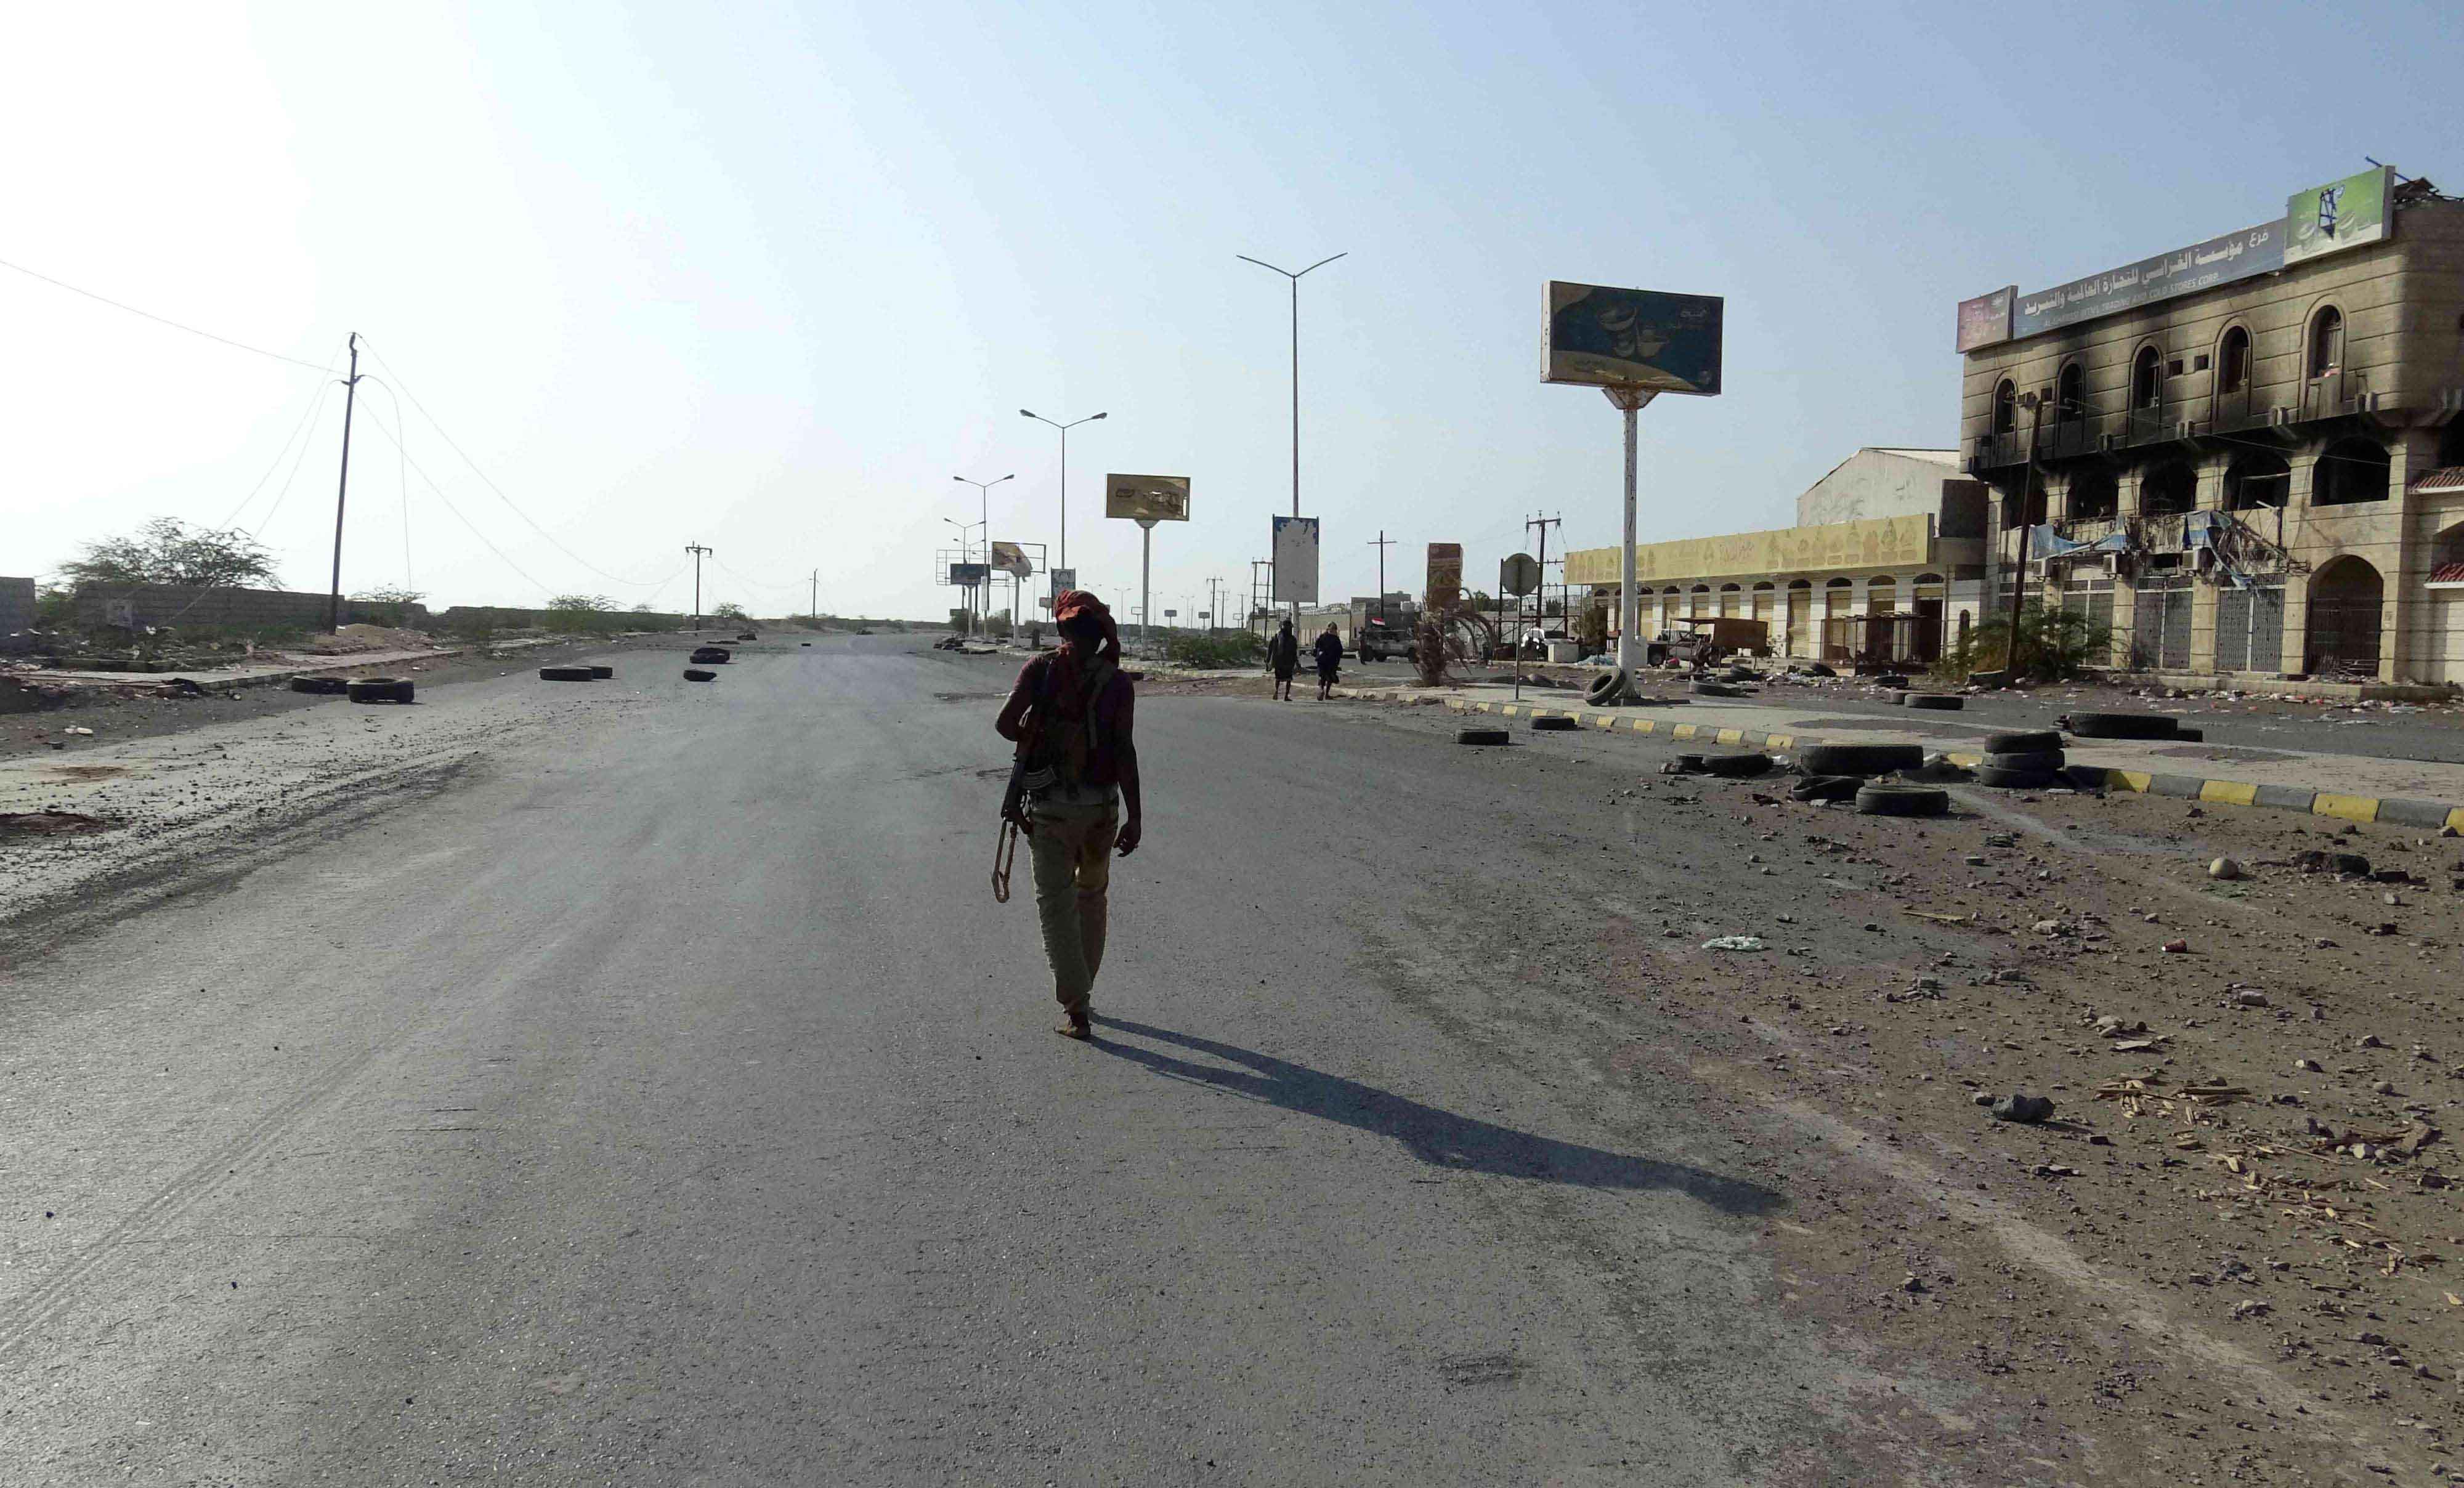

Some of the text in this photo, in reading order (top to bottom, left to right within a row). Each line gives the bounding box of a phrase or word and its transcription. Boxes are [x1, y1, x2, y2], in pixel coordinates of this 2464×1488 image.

[2249, 229, 2269, 247] فرع
[2195, 240, 2243, 265] مؤسسة
[2067, 279, 2100, 304] العالمية
[2102, 268, 2139, 296] للتجارة
[2170, 278, 2196, 293] STORES
[2025, 290, 2064, 315] والتبريد
